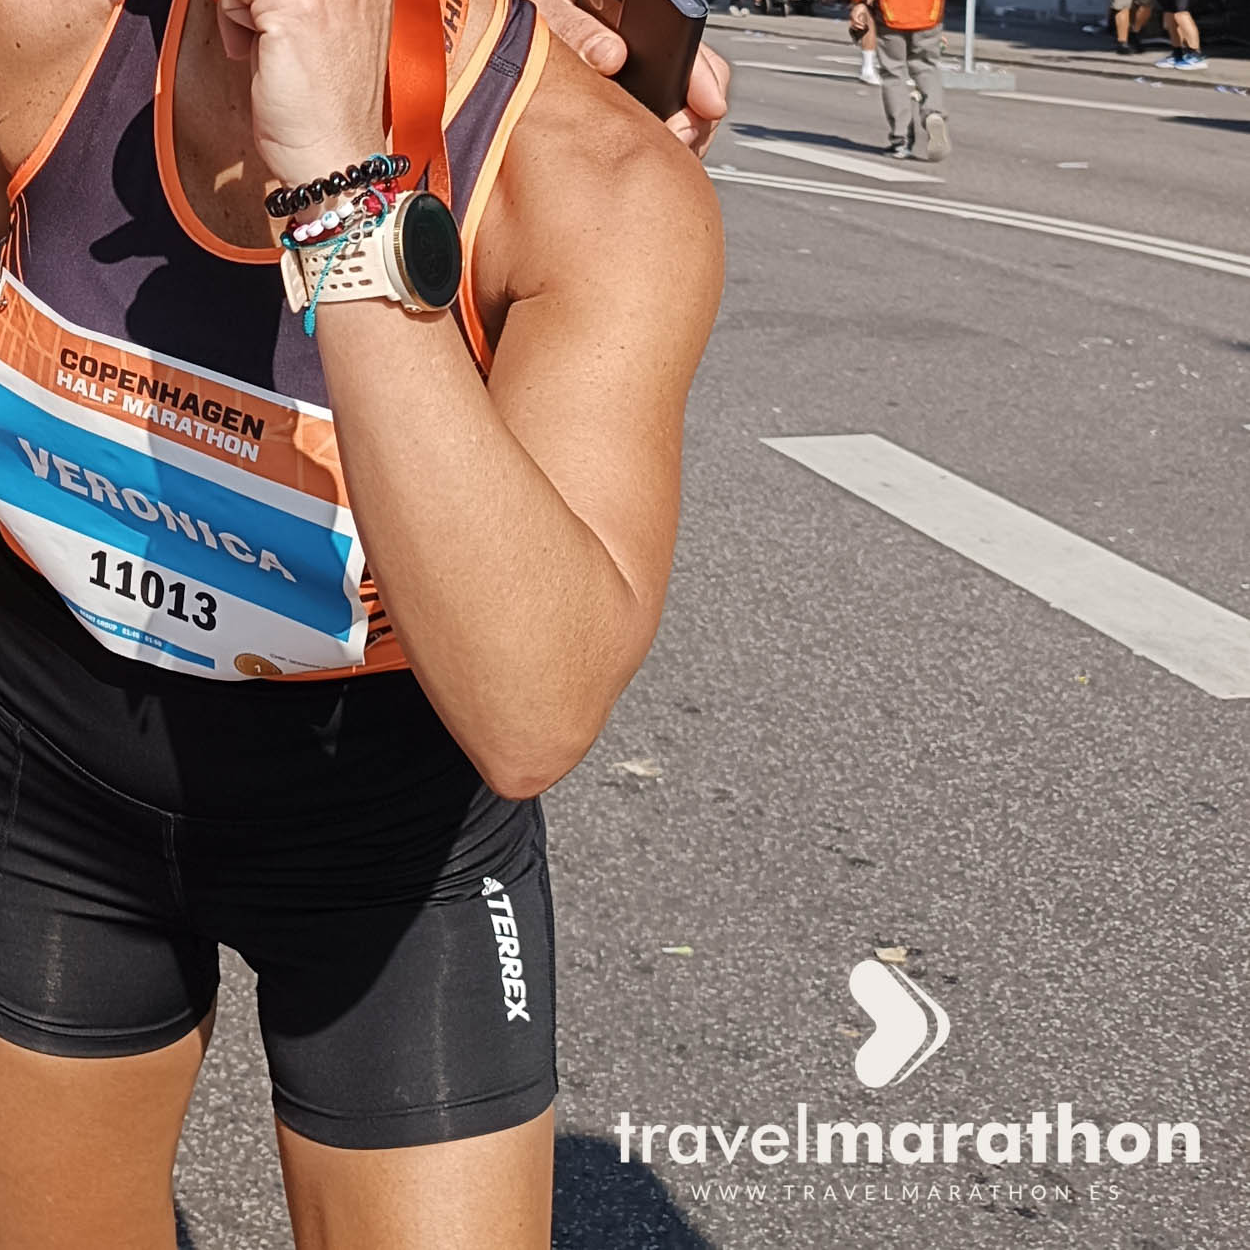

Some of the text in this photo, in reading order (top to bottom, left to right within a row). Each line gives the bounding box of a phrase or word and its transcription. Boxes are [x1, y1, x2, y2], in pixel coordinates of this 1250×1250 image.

[56, 368, 260, 463] HALF MARATHON
[59, 347, 265, 442] COPENHAGEN
[16, 435, 297, 584] VERONICA
[88, 549, 219, 632] 11013
[486, 893, 531, 1022] TERREX
